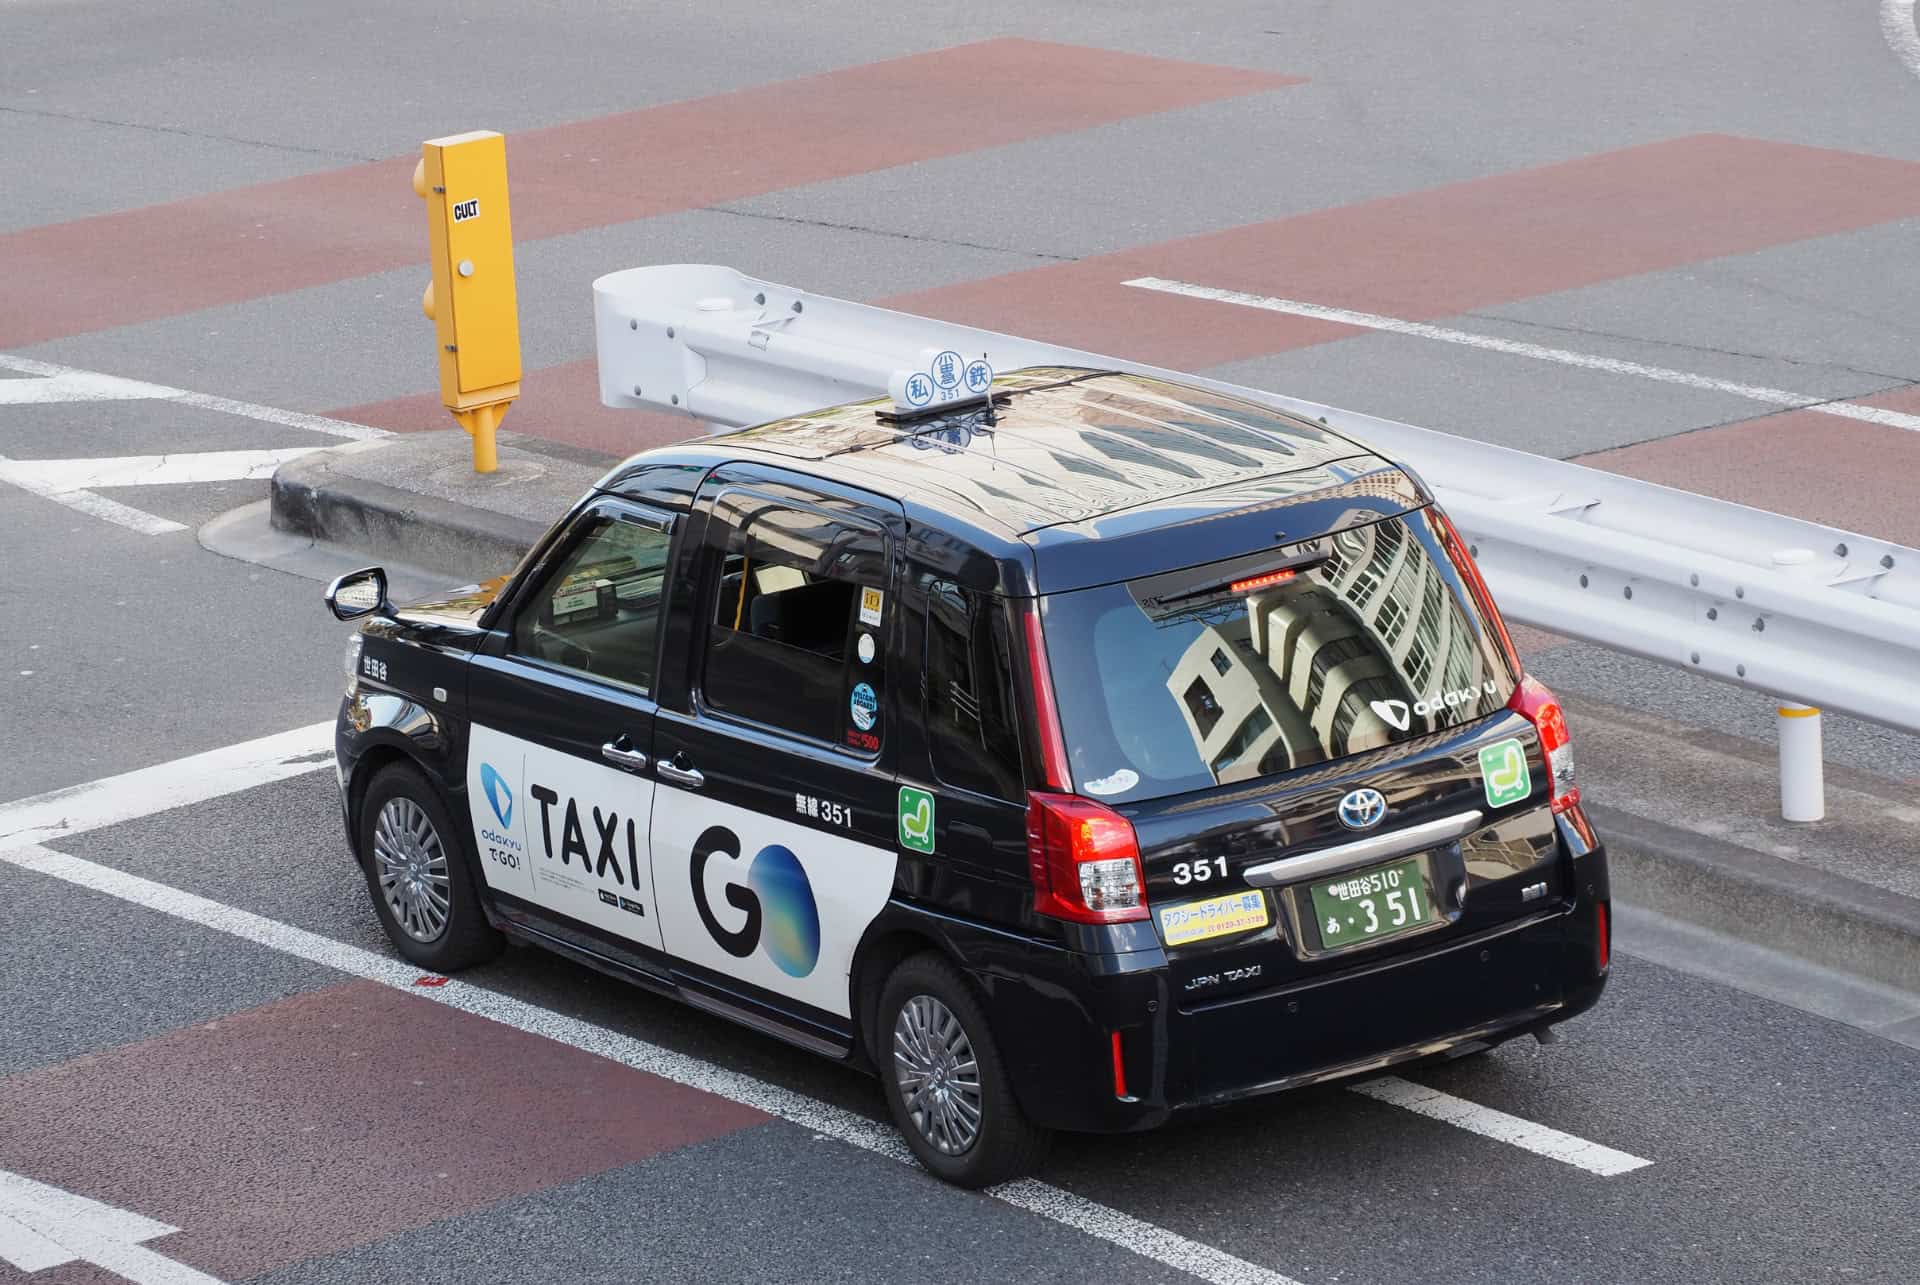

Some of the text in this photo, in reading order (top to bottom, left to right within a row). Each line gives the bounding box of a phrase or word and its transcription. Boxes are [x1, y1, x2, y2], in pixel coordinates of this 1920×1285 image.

[454, 200, 477, 220] CULT
[911, 378, 929, 399] 私
[941, 389, 960, 400] 351
[363, 656, 387, 681] 世田谷
[821, 801, 852, 828] 351
[481, 829, 521, 851] odakyu
[531, 784, 640, 891] TAXI
[1173, 856, 1228, 885] 351
[1185, 965, 1262, 990] JPN TAXI
